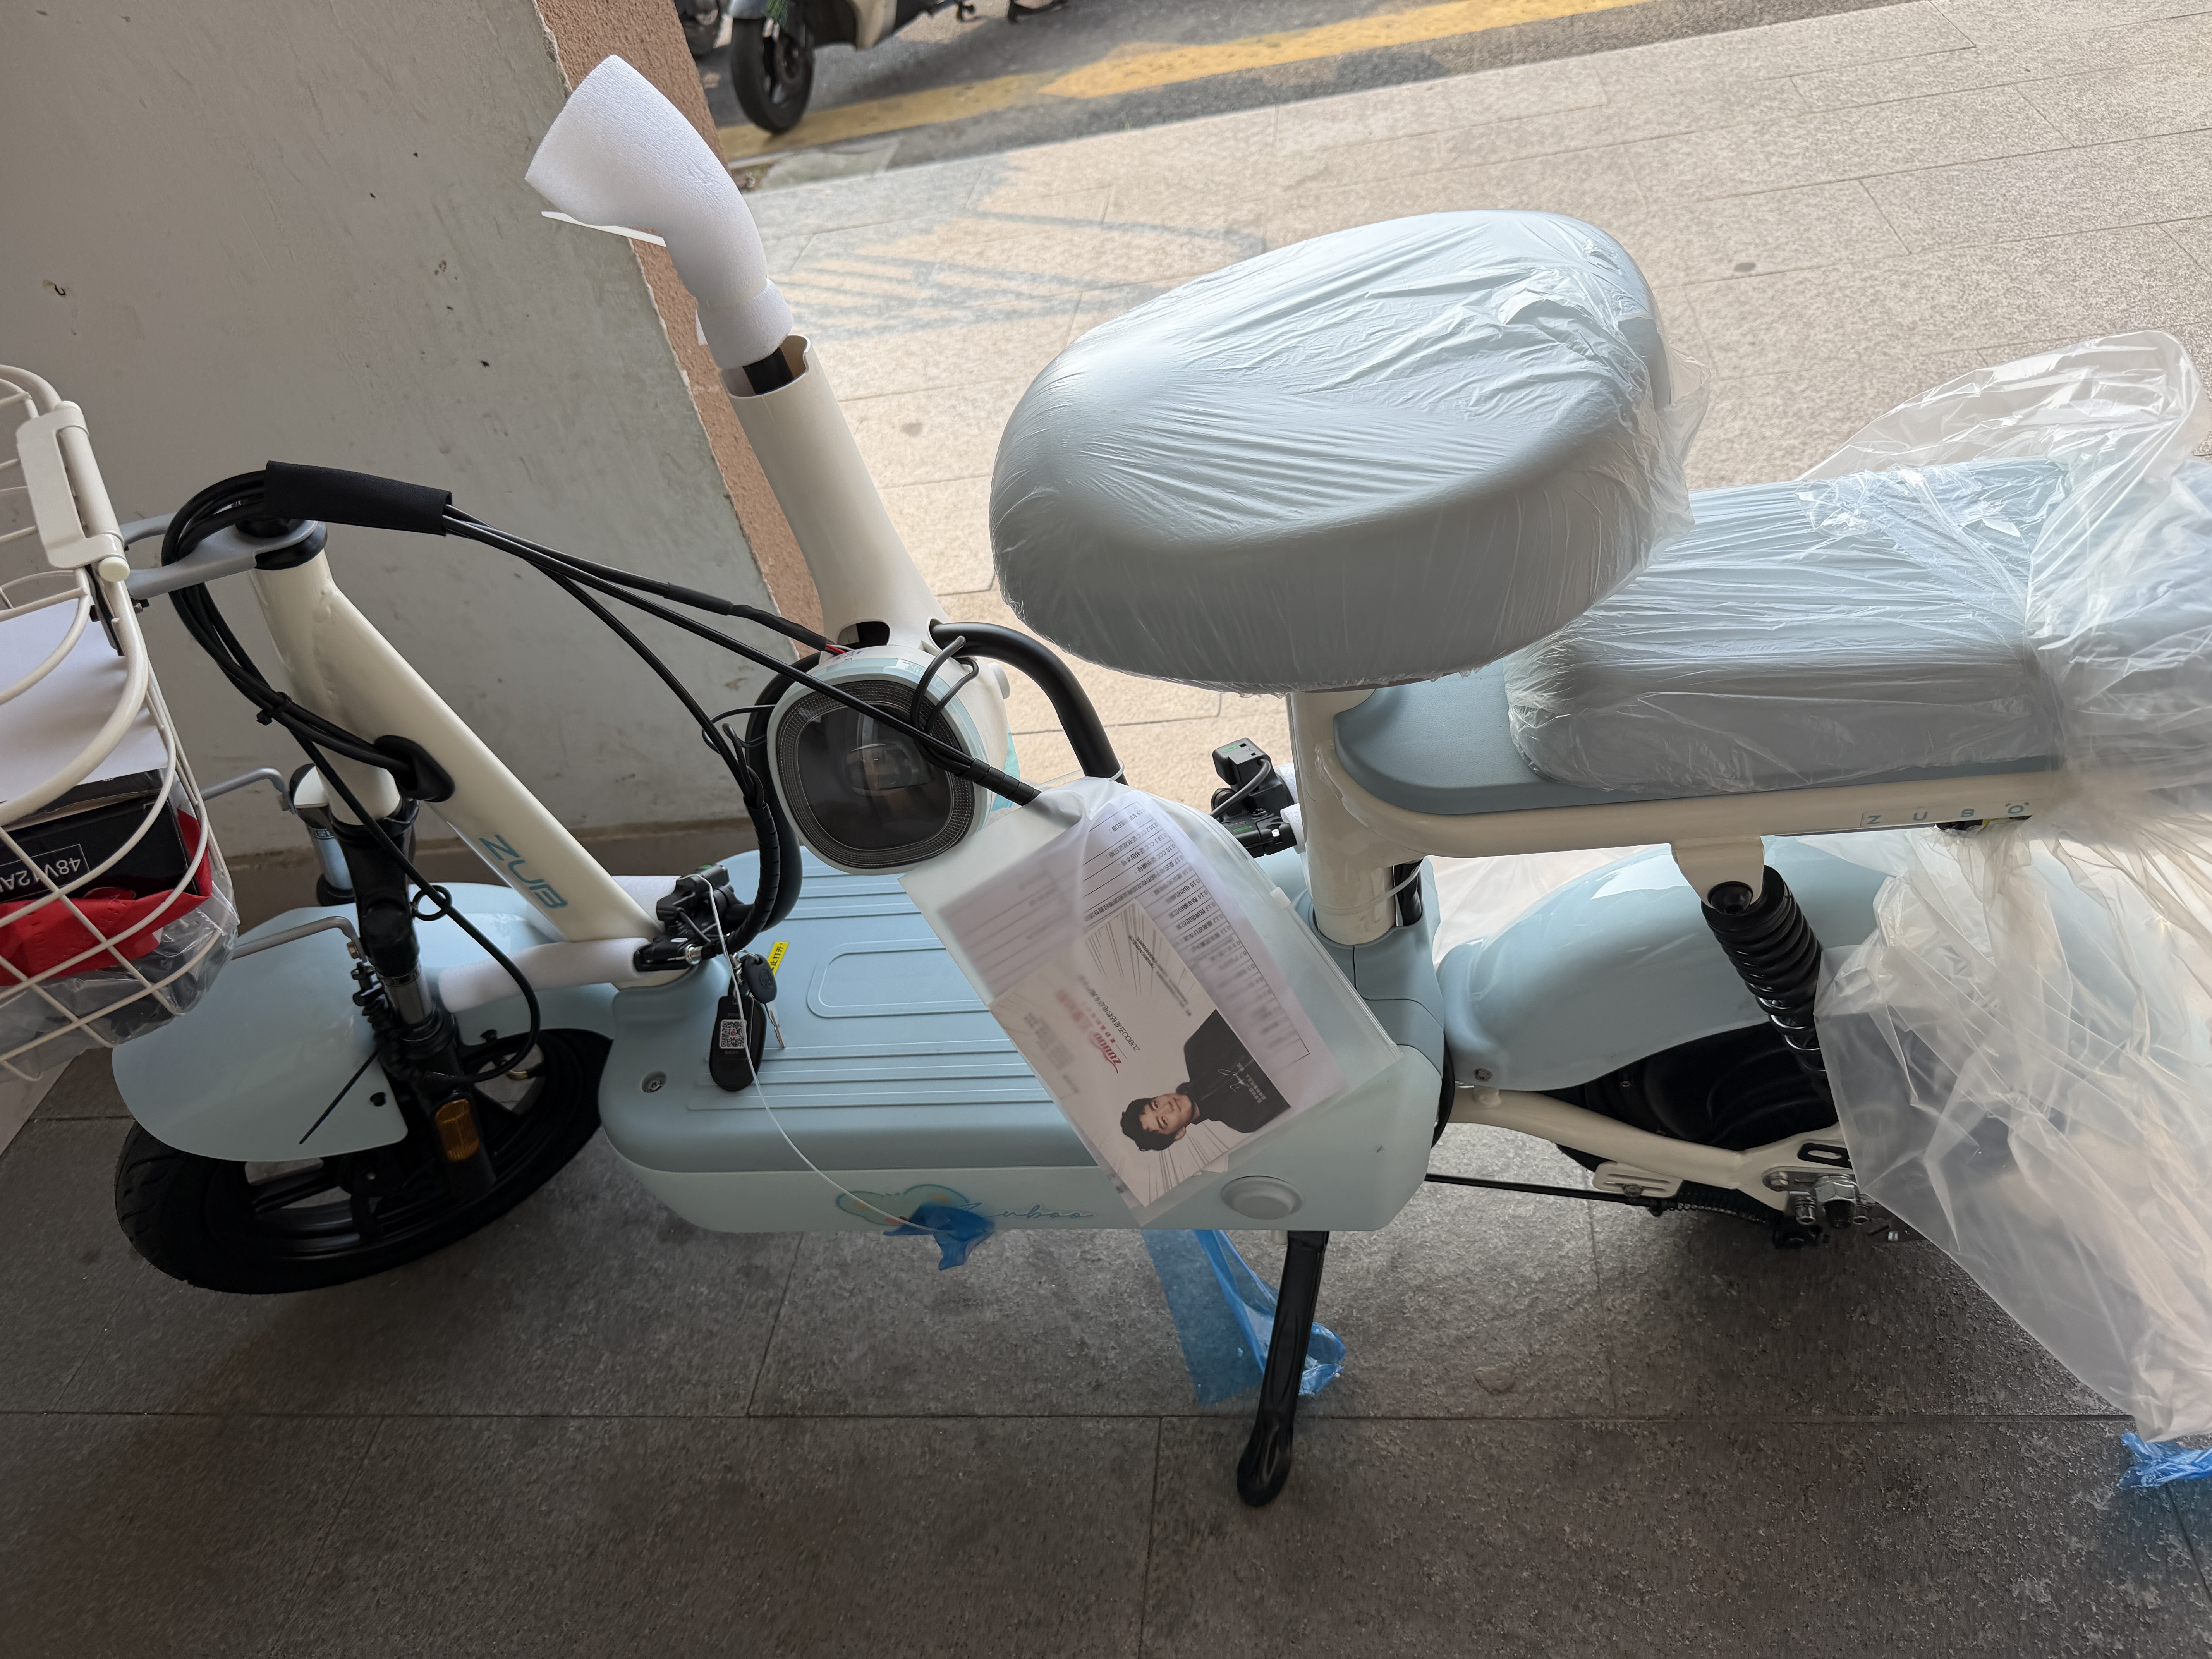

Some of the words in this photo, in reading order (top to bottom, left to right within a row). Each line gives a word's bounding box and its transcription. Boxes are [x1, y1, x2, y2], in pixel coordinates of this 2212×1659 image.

[1146, 822, 1158, 833] 0.18.2
[1136, 830, 1147, 839] CCC
[1154, 833, 1167, 843] 0.18.1
[1144, 841, 1155, 850] CCC
[1166, 843, 1176, 854] 0.18
[1156, 850, 1167, 860] CCC
[1173, 854, 1184, 864] 0.17
[1189, 878, 1200, 888] 0.15
[1197, 890, 1208, 899] 0.14
[1205, 902, 1216, 911] 0.13
[1212, 913, 1224, 923] 0.12
[769, 946, 784, 970] 止打开
[1076, 974, 1140, 1053] ZUBOO五星钻豹电动车用户
[1092, 1030, 1122, 1066] ZUBOO
